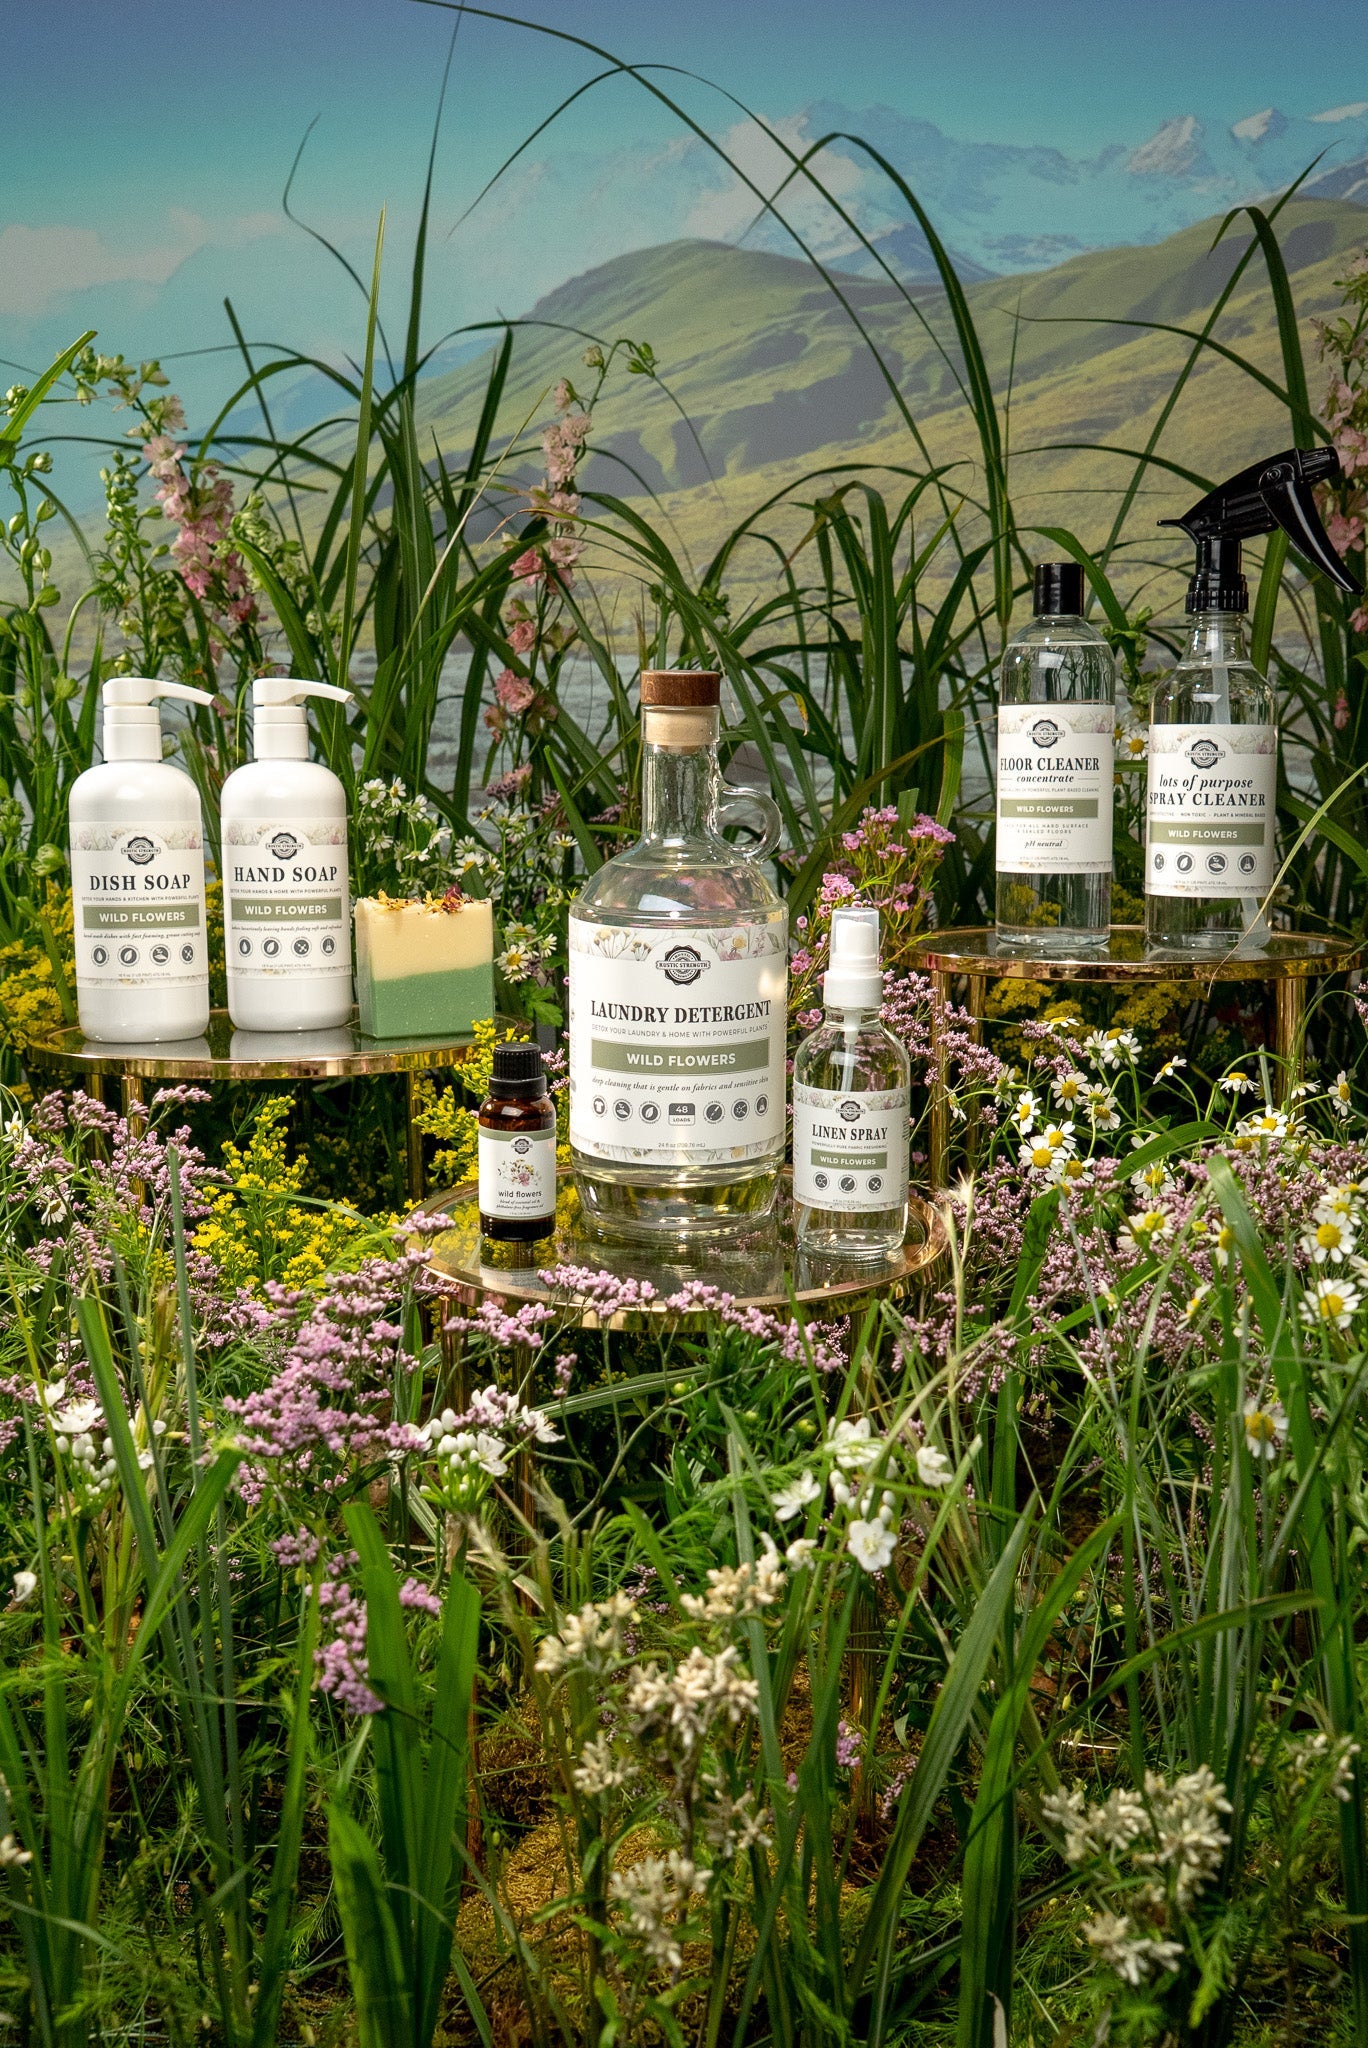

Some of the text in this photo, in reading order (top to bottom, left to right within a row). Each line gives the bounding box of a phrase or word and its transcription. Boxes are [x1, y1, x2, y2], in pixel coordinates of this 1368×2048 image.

[1000, 757, 1100, 771] FLOOR CLEANER
[1016, 774, 1074, 783] concentrate
[1159, 774, 1254, 791] lots of purpose
[1150, 792, 1266, 806] SPRAY CLEANER
[1168, 830, 1238, 838] WILD FLOWERS
[234, 866, 337, 882] HAND SOAP
[90, 874, 191, 891] DISH SOAP
[99, 911, 186, 923] WILD FLOWERS
[244, 905, 328, 915] WILD FLOWERS
[591, 1000, 771, 1023] LAUNDRY DETERGENT
[592, 1024, 608, 1032] DETOX
[610, 1026, 626, 1034] YOUR
[713, 1028, 748, 1037] POWERFUL
[749, 1024, 768, 1033] PLANTS
[626, 1053, 736, 1067] WILD FLOWERS
[605, 1078, 632, 1091] cleaning
[633, 1082, 648, 1090] that
[656, 1084, 679, 1093] gentle
[691, 1084, 717, 1093] fabrics
[719, 1081, 733, 1090] and
[734, 1079, 759, 1089] sensitive
[759, 1076, 769, 1084] skin
[675, 1106, 689, 1114] 48
[812, 1124, 847, 1140] LINEN
[850, 1127, 888, 1140] SPRAY
[820, 1156, 839, 1164] WILD
